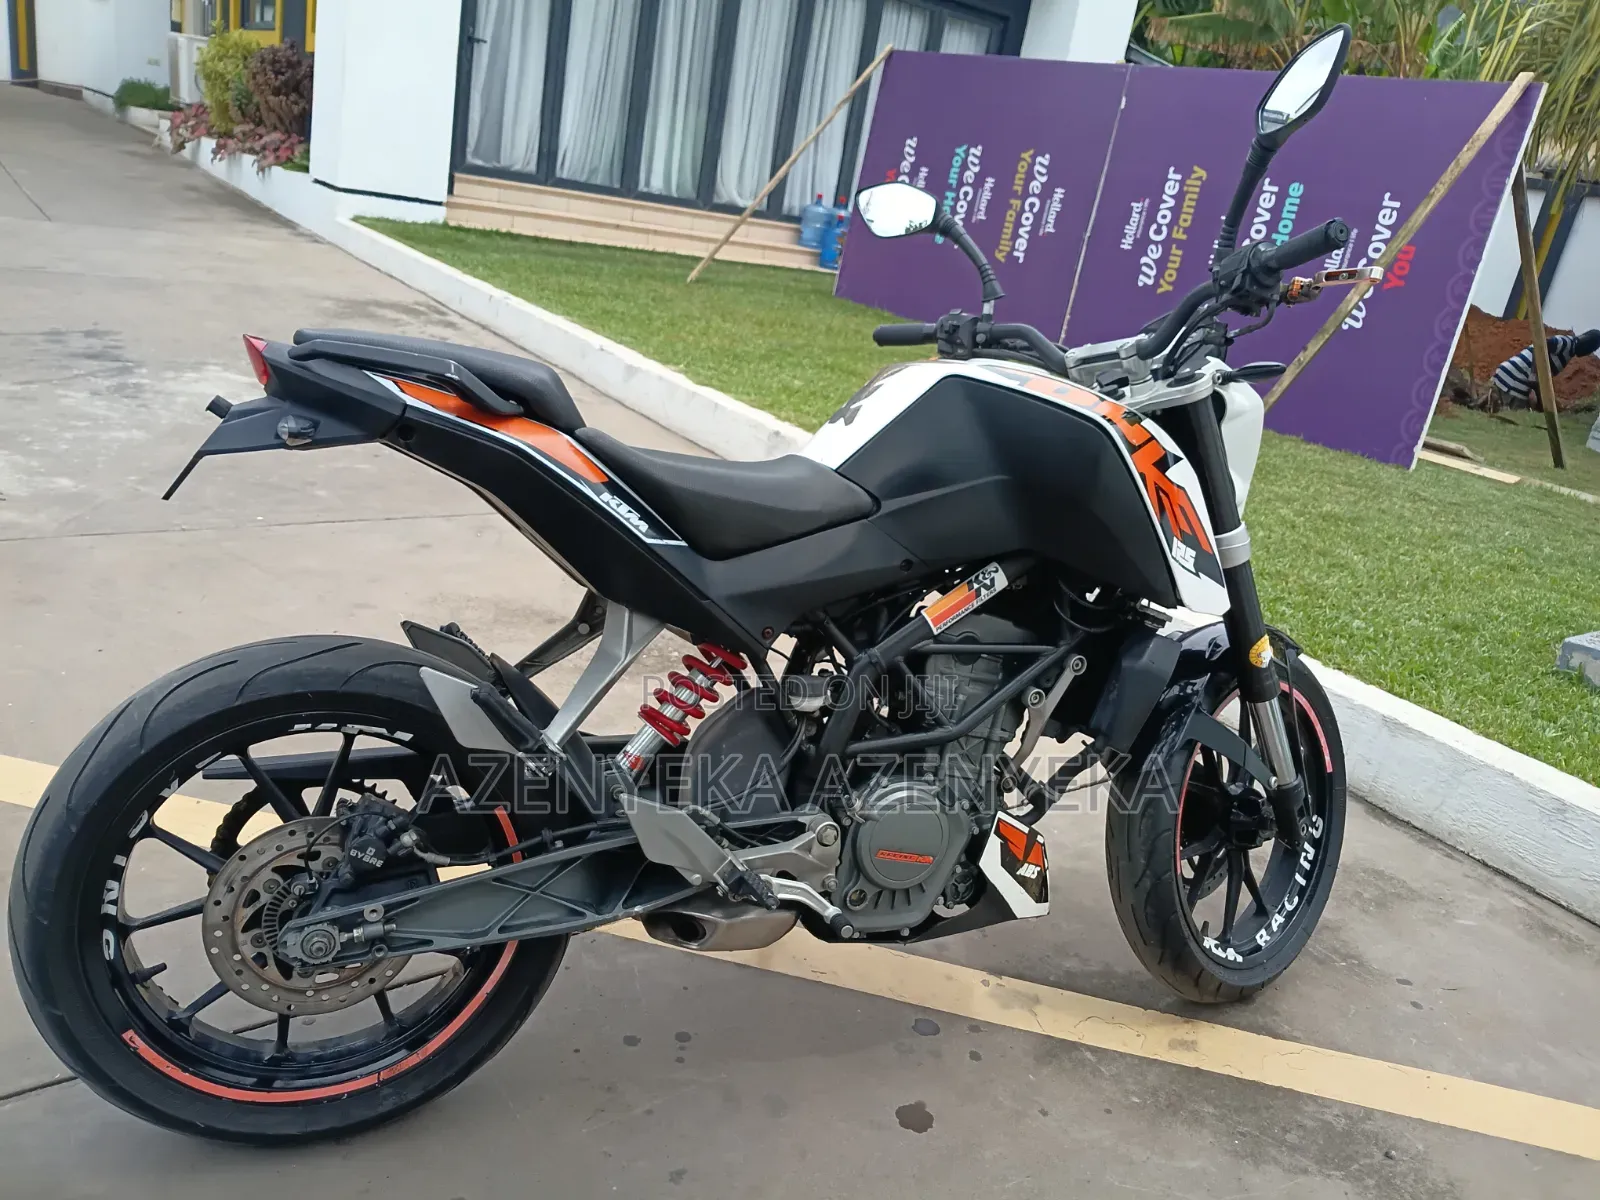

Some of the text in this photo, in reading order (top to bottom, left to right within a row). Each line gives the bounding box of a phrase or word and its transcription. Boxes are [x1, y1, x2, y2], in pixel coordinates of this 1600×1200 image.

[899, 136, 918, 174] We
[947, 144, 968, 188] Your
[962, 145, 983, 184] We
[1028, 153, 1051, 195] We
[916, 166, 929, 189] Holl
[976, 177, 995, 220] Hollard
[994, 148, 1035, 263] Your Family
[1045, 187, 1066, 233] Hollard
[1148, 165, 1182, 242] Cover
[1012, 196, 1041, 264] Cover
[1120, 202, 1143, 250] Hollard
[1156, 165, 1208, 294] Your Family
[1137, 243, 1163, 287] We
[1382, 244, 1417, 291] You
[599, 491, 649, 533] KTM
[935, 587, 998, 632] PERFORMANCE FILTERS
[349, 848, 384, 868] BYBRE
[1016, 862, 1041, 879] ABS
[1254, 813, 1325, 948] RACING
